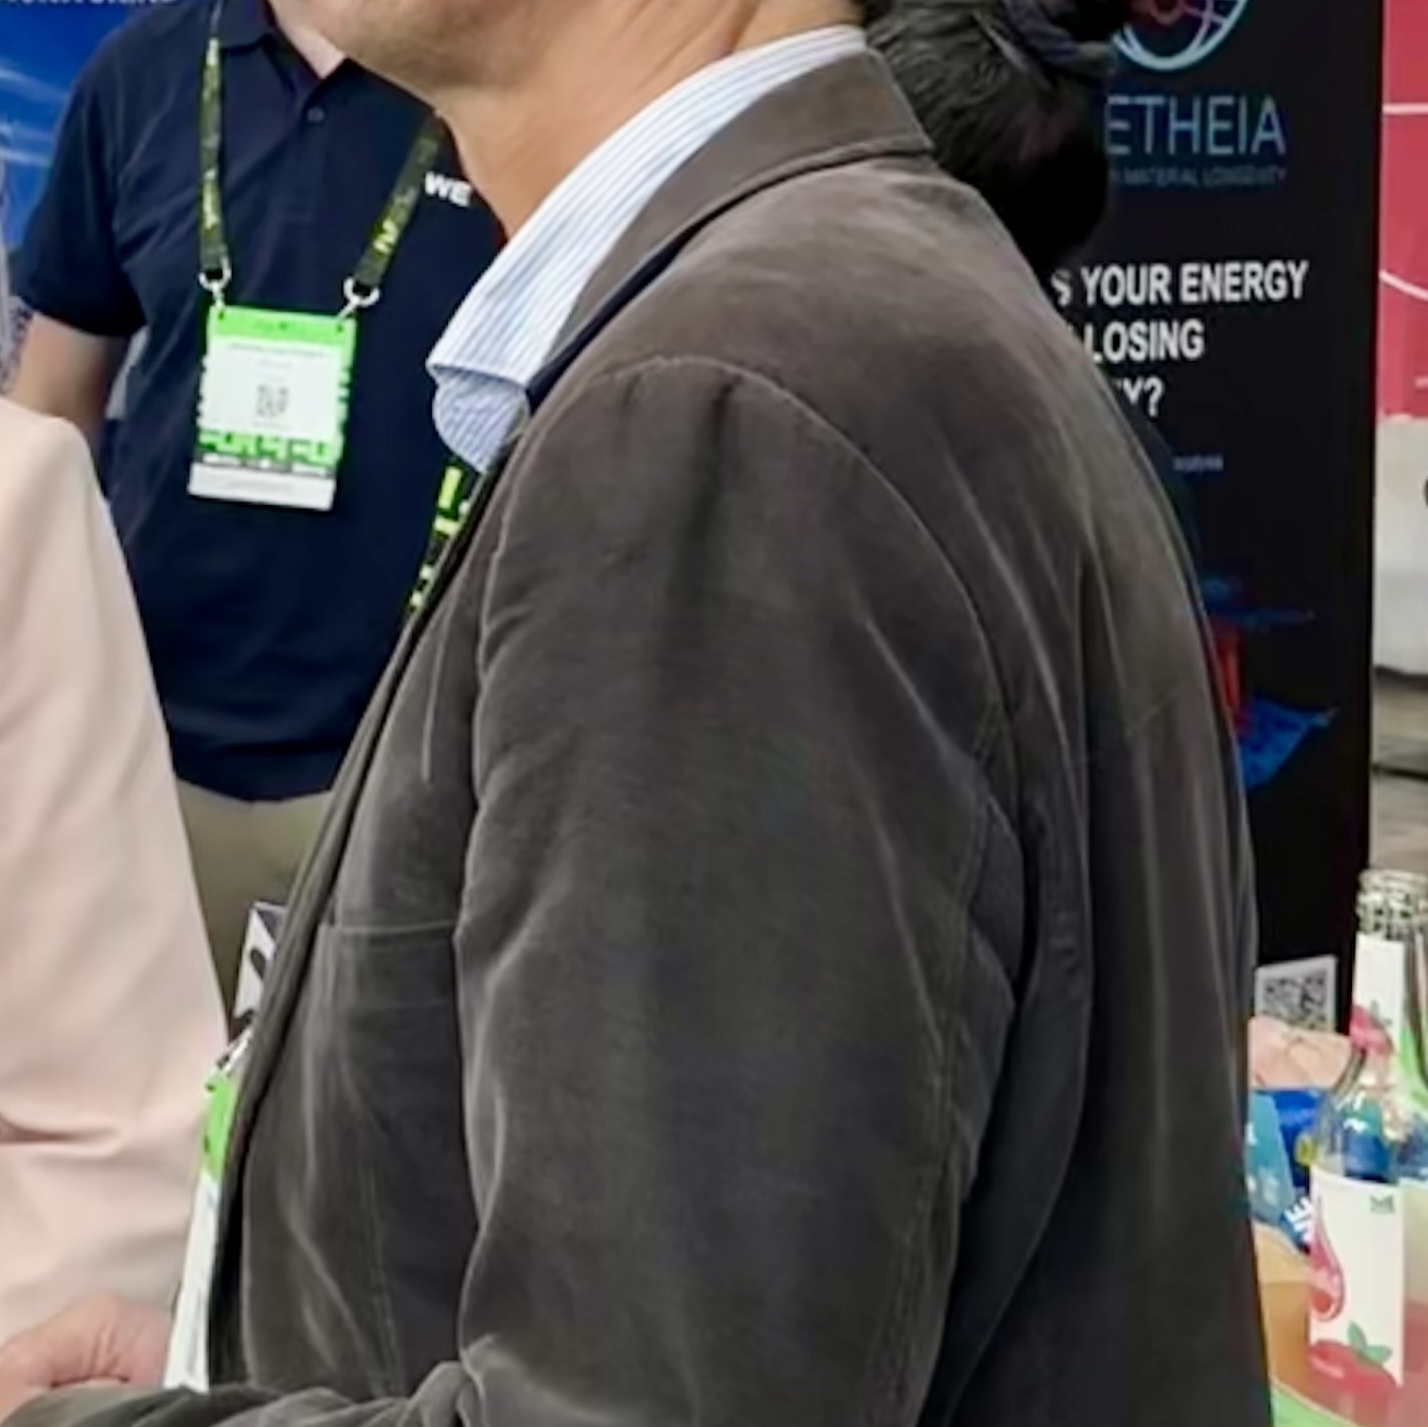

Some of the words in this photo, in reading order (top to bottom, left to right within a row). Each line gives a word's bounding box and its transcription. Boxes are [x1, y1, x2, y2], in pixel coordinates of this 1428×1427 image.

[1104, 95, 1287, 155] ETHEIA
[425, 172, 472, 207] WE
[1080, 264, 1171, 306] YOUR
[1180, 259, 1309, 303] ENERGY
